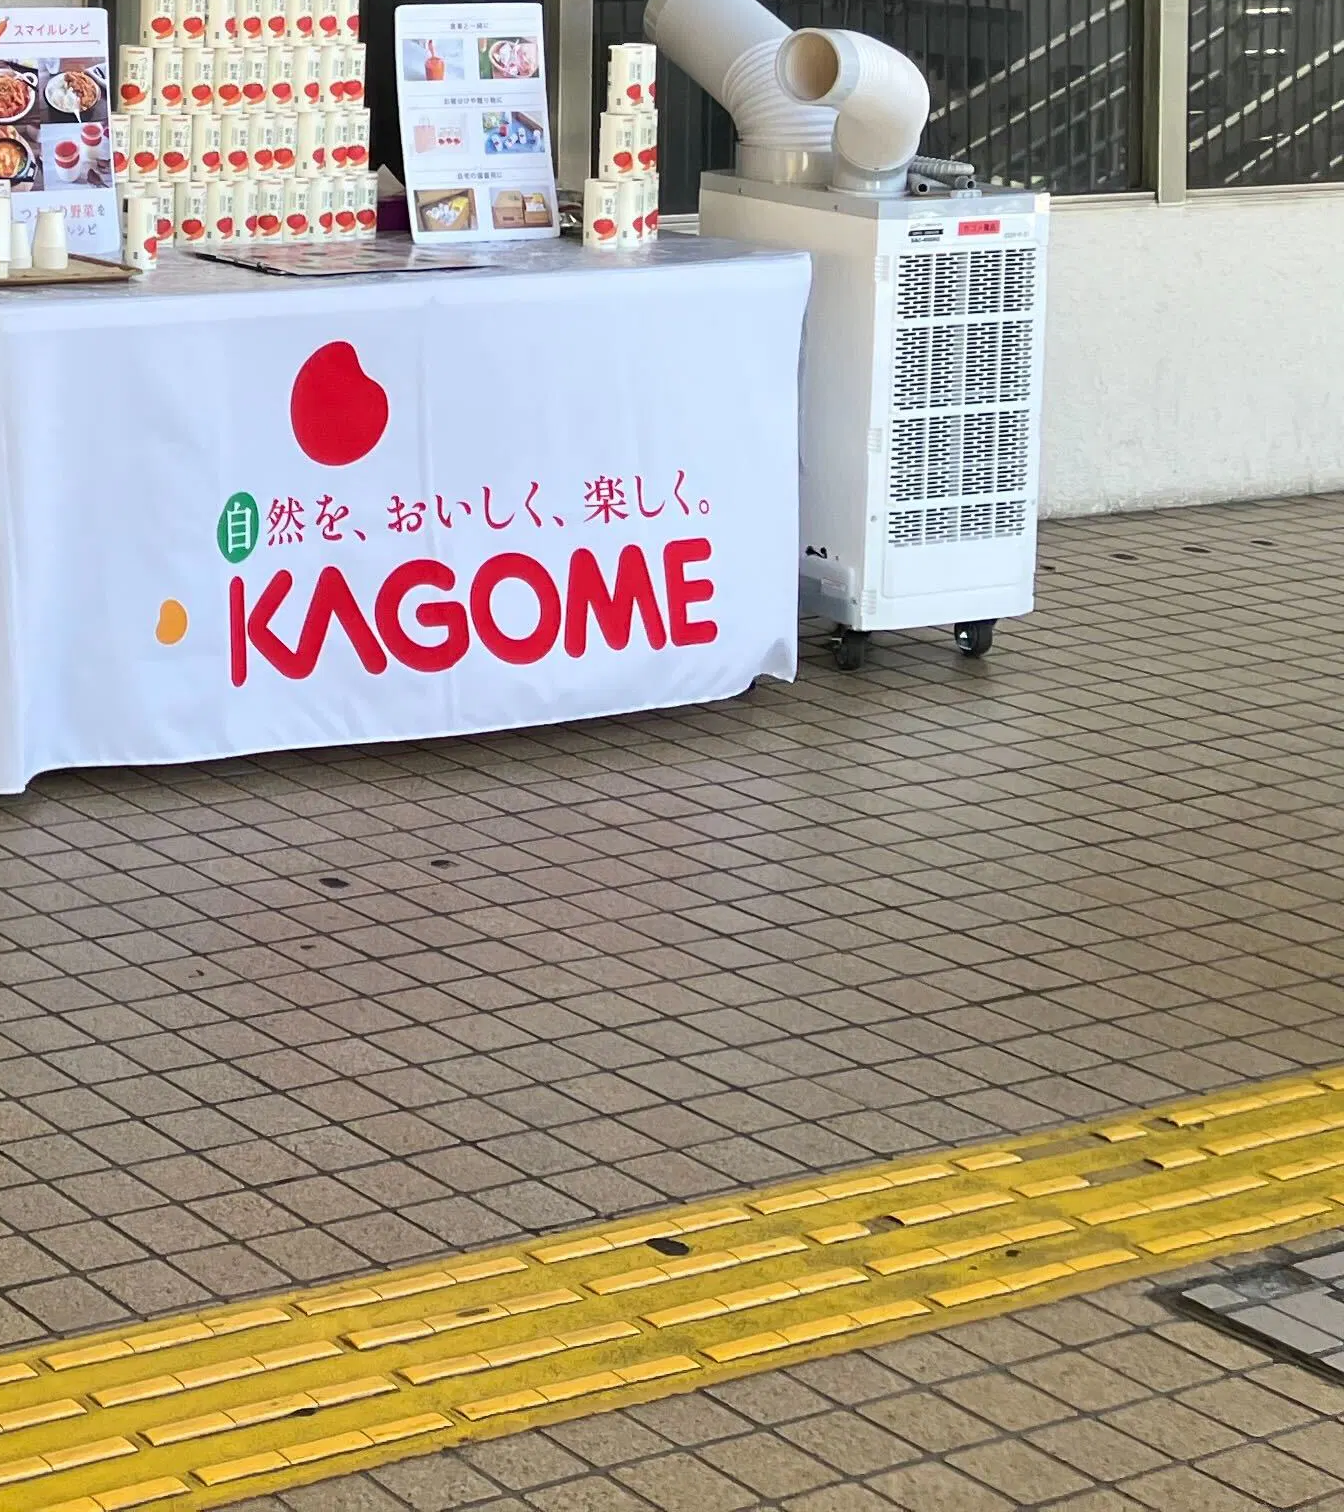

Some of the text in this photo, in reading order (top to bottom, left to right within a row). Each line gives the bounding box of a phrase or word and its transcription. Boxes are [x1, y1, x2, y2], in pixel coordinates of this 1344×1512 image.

[14, 23, 90, 37] スマイルレシピ
[229, 538, 717, 687] KAGOME
